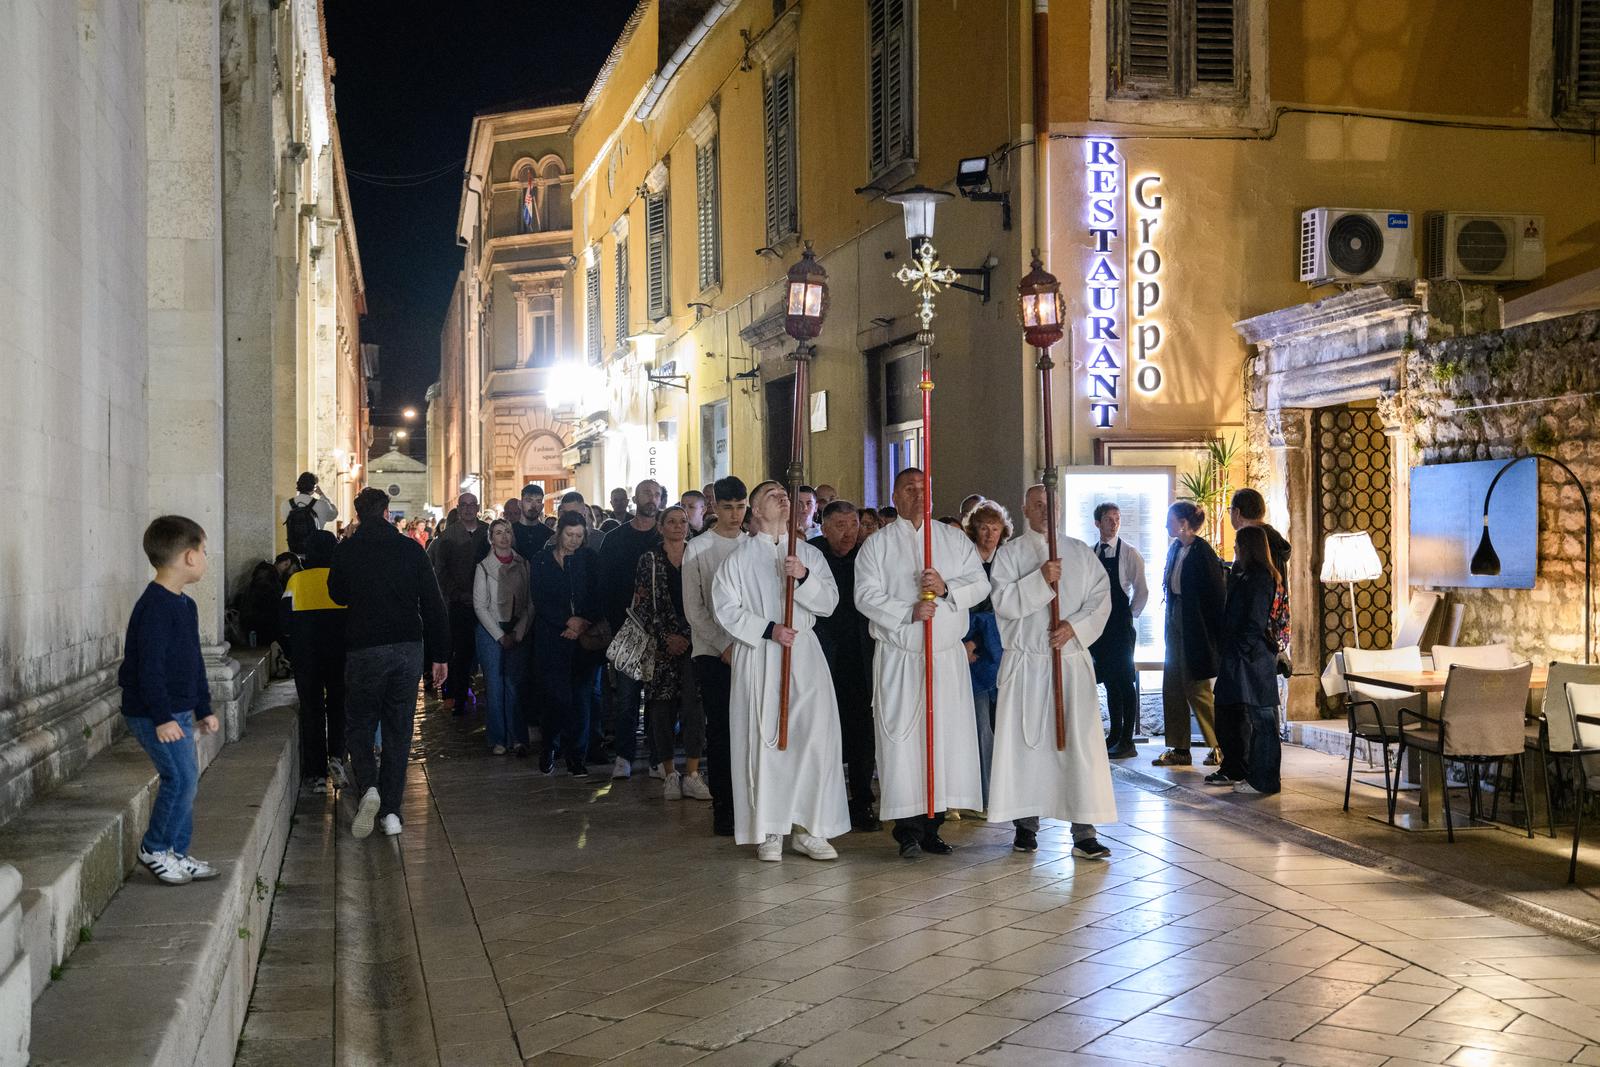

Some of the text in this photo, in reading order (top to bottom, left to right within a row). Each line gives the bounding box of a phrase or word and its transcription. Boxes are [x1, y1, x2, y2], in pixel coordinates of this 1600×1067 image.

[1086, 140, 1121, 428] RESTAURANT
[1134, 175, 1163, 393] Groppo
[648, 446, 657, 482] GER
